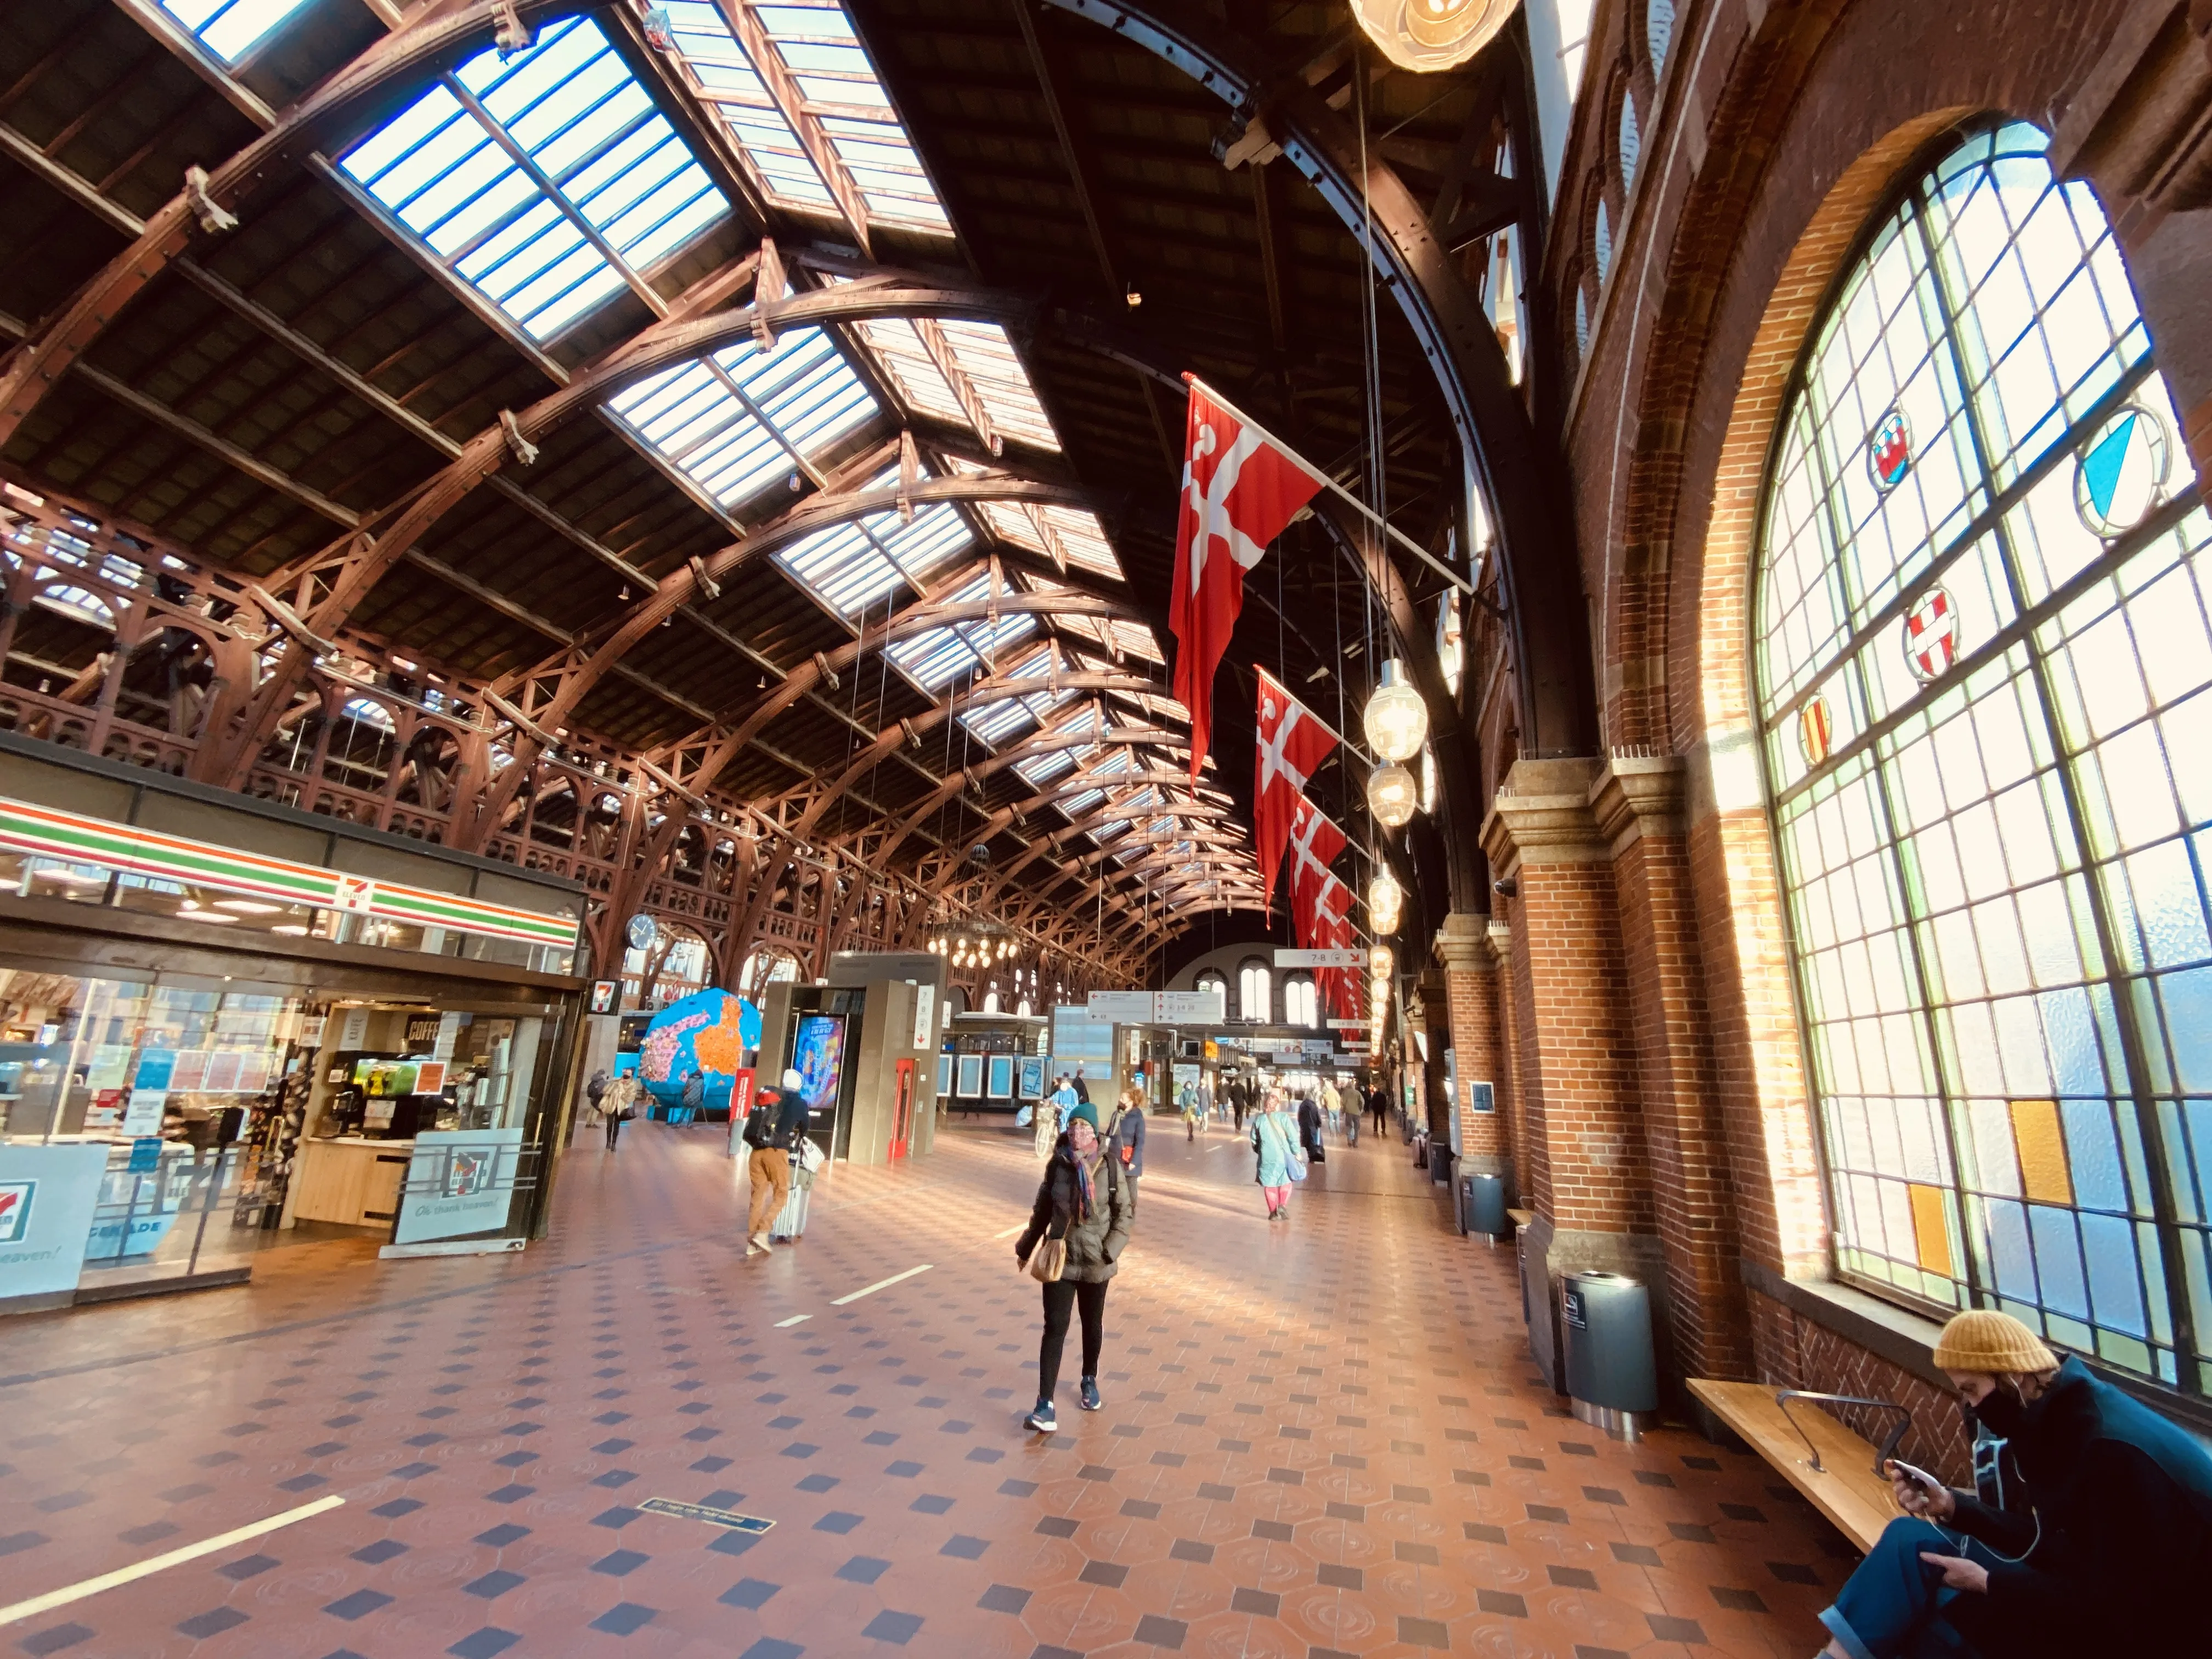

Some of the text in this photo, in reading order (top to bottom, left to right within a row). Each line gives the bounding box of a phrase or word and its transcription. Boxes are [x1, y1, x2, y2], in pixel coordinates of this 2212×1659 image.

[346, 878, 368, 908] 7
[597, 984, 612, 1012] 7
[434, 1204, 460, 1215] thank
[462, 1197, 499, 1211] heaven!
